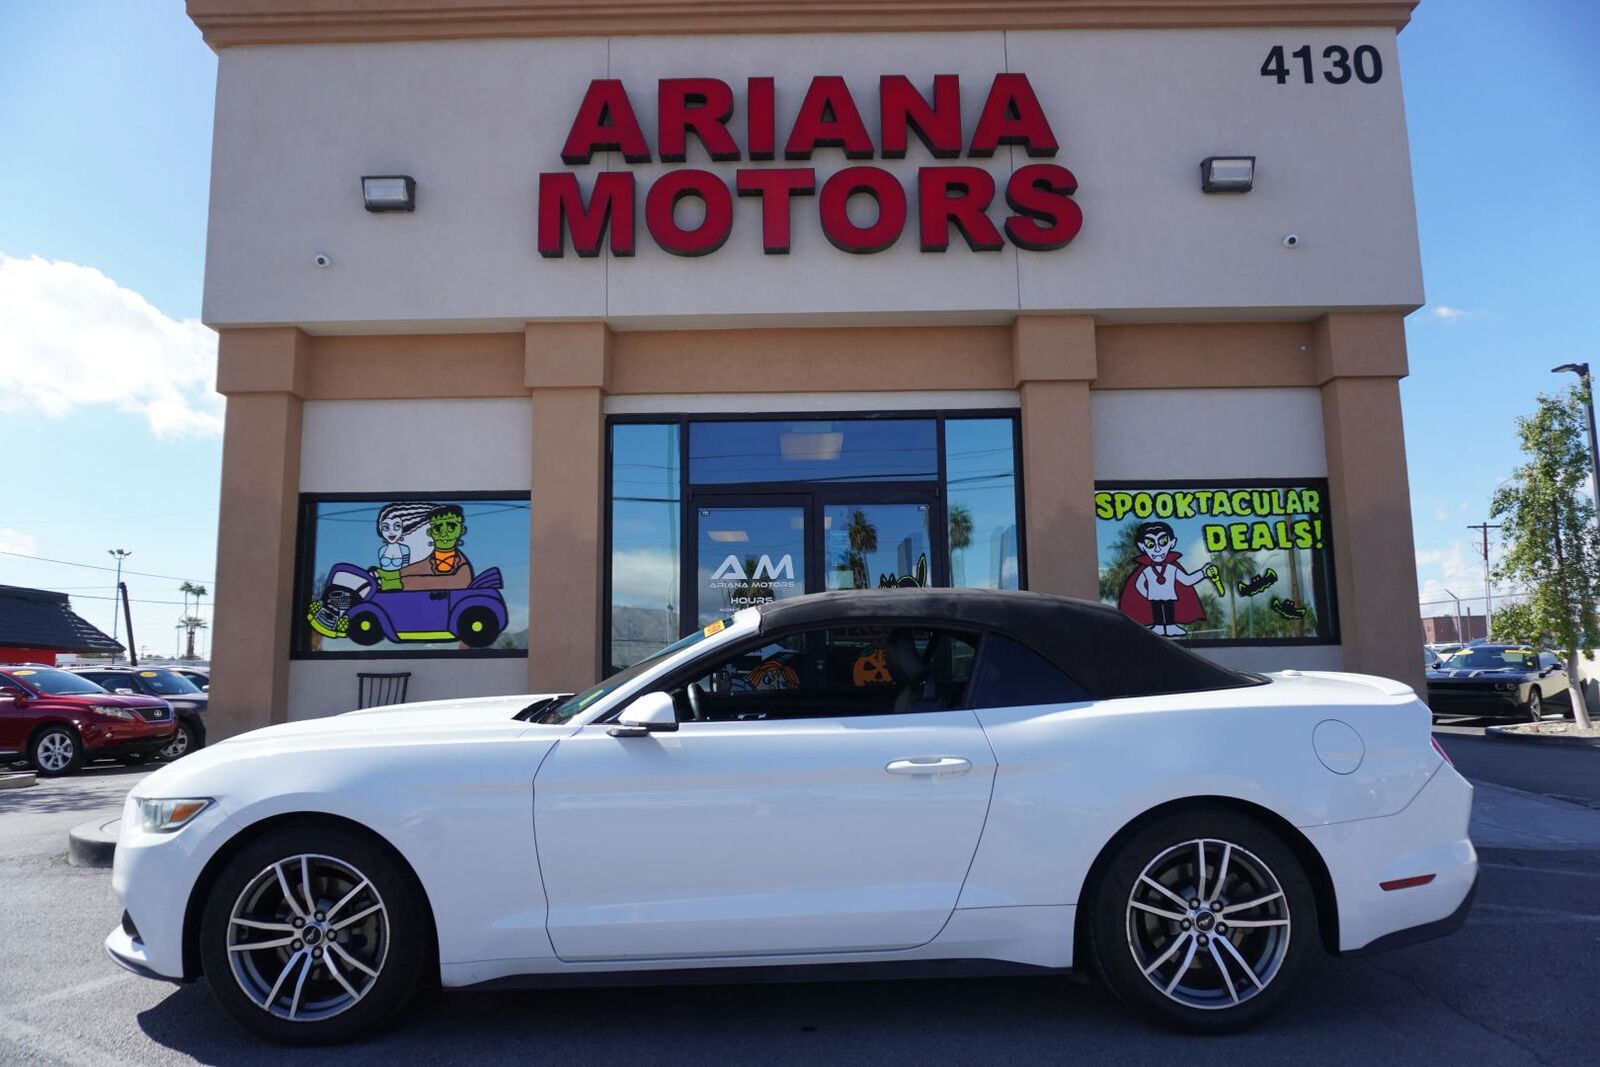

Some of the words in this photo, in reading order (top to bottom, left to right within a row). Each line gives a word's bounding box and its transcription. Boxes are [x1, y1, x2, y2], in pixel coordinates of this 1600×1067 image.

[1260, 45, 1383, 84] 4130
[561, 73, 1059, 164] ARIANA
[537, 164, 1083, 258] MOTORS
[1094, 488, 1321, 520] SPOOKTACULAR
[1204, 519, 1323, 552] DEALS!
[710, 554, 795, 580] AM
[709, 581, 749, 589] ARIANA
[751, 581, 795, 589] MOTORS
[731, 596, 774, 606] HOURS
